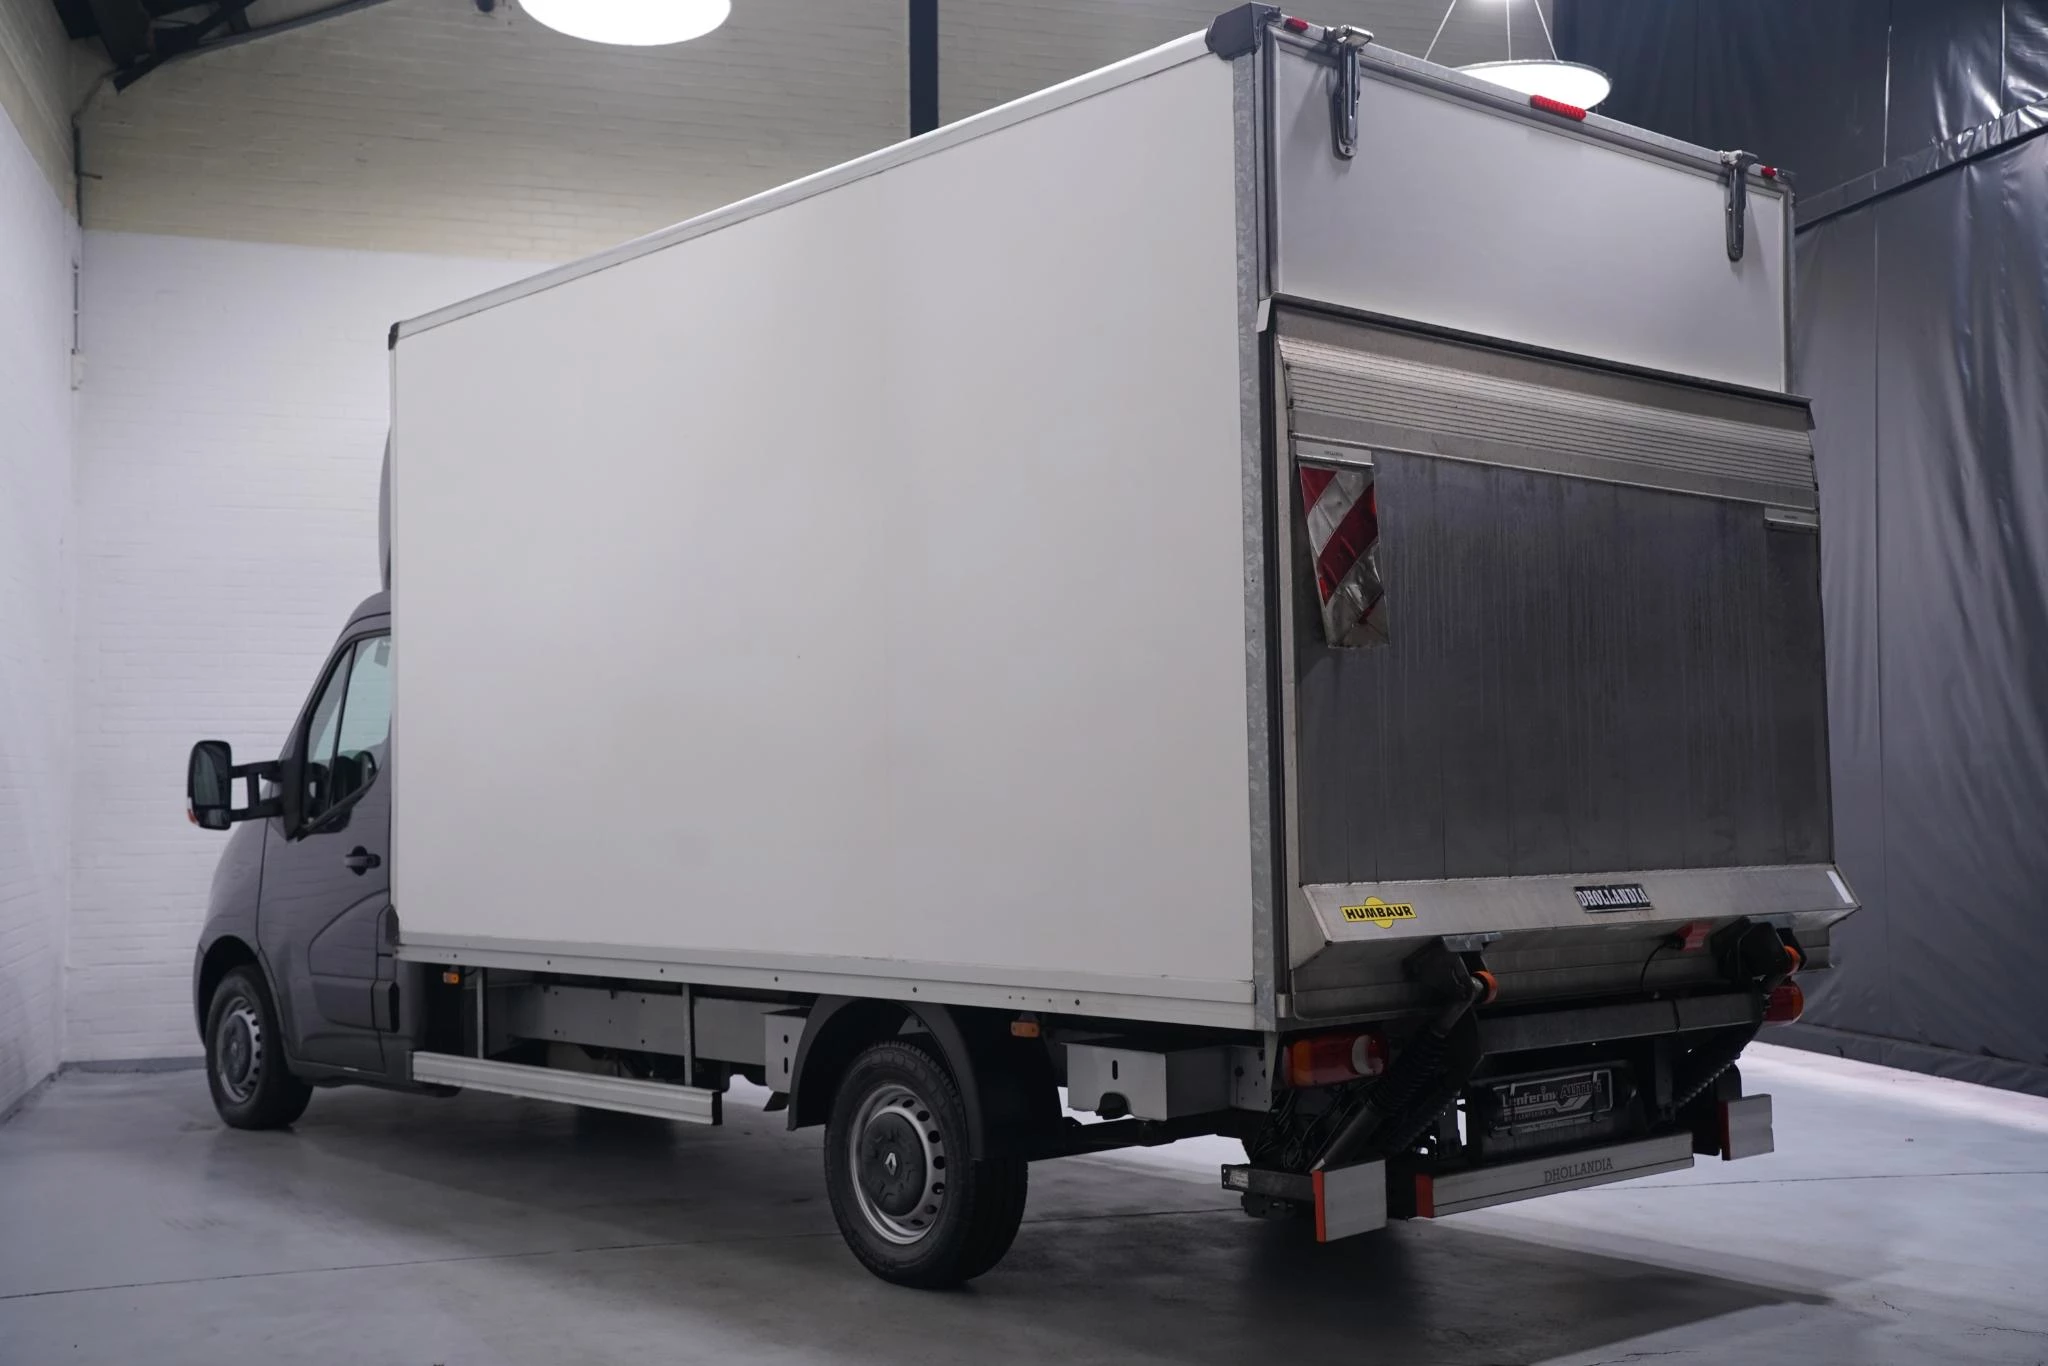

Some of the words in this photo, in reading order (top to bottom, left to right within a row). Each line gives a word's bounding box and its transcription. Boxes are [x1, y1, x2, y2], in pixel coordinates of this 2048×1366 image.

[1576, 887, 1649, 906] DHOLLANDIA
[1345, 906, 1415, 919] HUMBAUR
[1544, 1158, 1613, 1183] DHOLLANDIA
